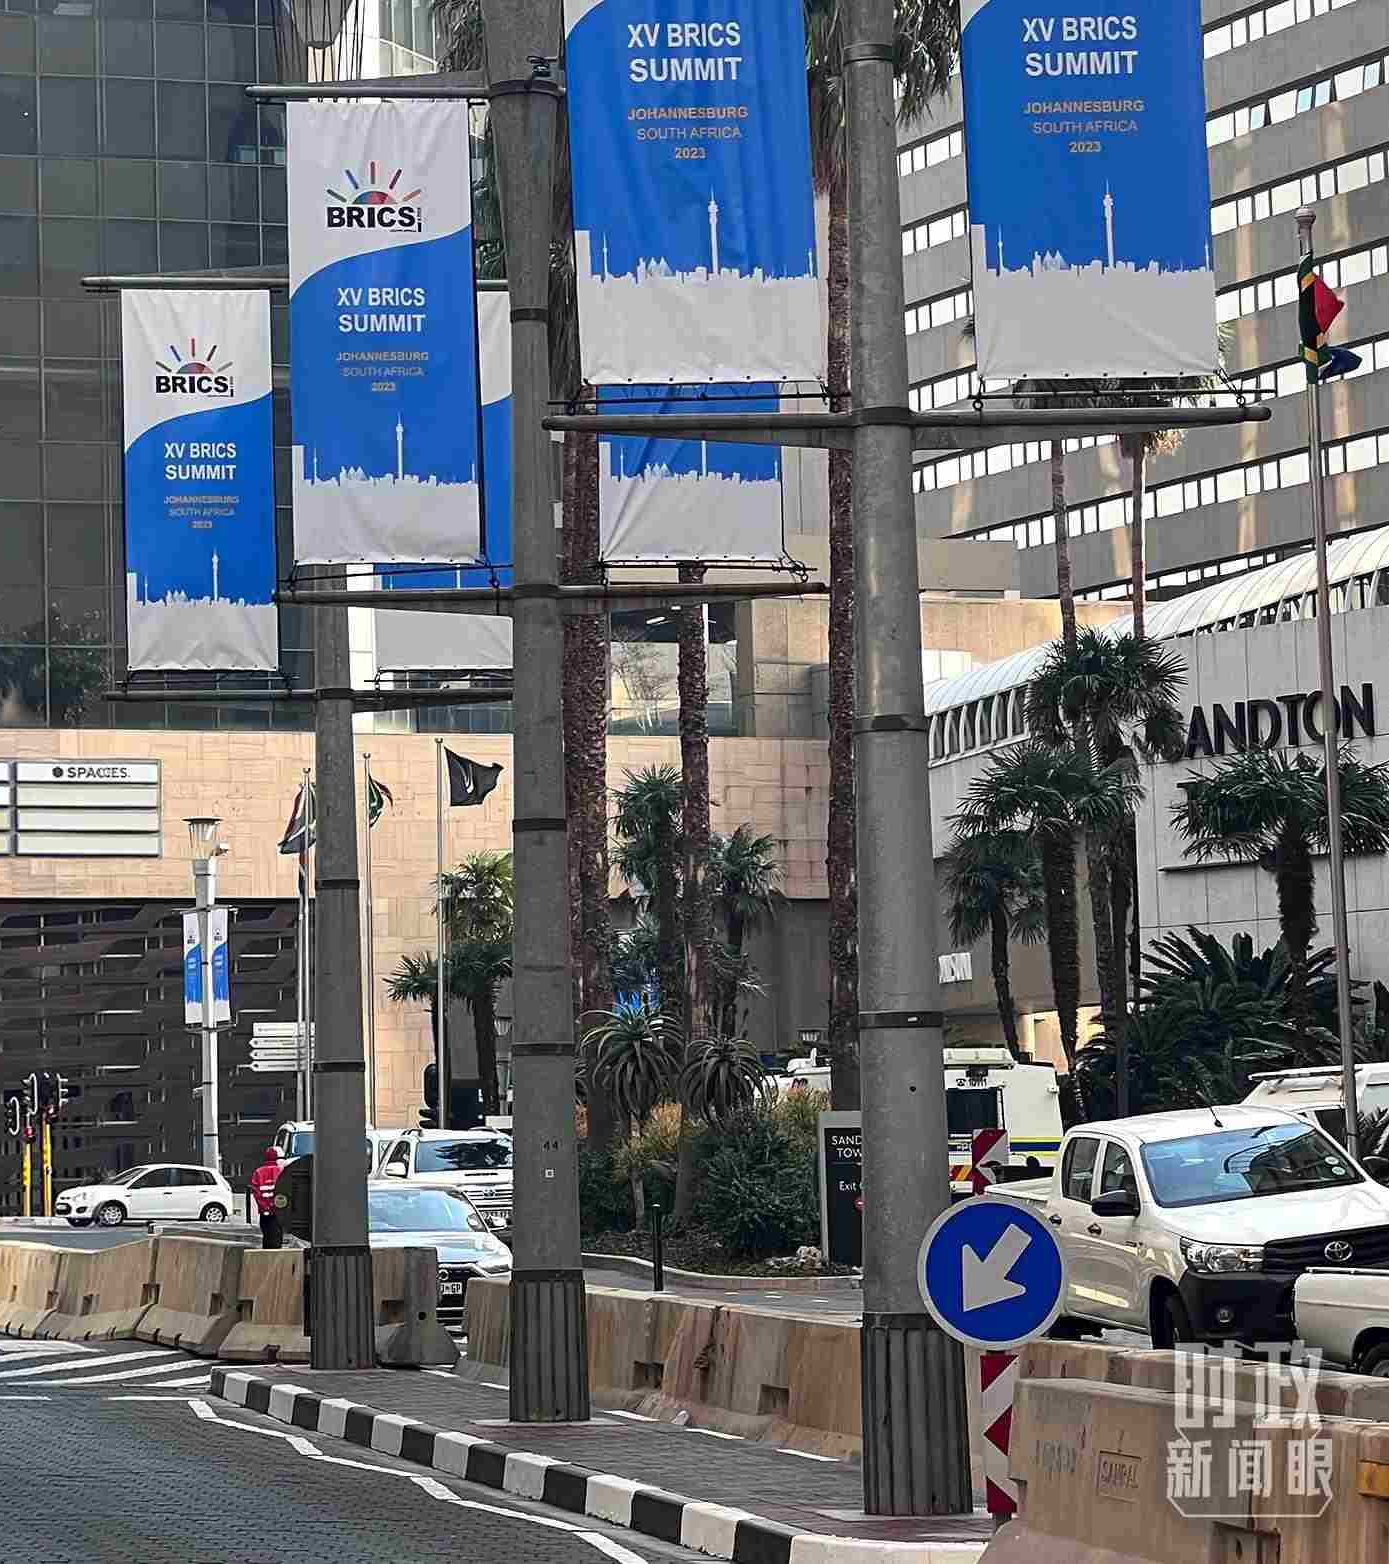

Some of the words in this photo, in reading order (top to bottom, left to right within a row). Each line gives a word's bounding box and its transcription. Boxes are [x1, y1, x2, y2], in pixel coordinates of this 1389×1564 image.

[627, 23, 660, 49] XV
[666, 21, 742, 48] BRICS
[1021, 17, 1055, 43] XV
[1061, 15, 1138, 42] BRICS
[629, 56, 743, 83] SUMMIT
[1024, 50, 1139, 77] SUMMIT
[627, 105, 749, 122] JOHANNESBURG
[1023, 99, 1145, 115] JOHANNESBURG
[636, 126, 687, 142] SOUTH
[690, 125, 742, 140] AFRICA
[1031, 119, 1083, 134] SOUTH
[1085, 118, 1139, 133] AFRICA
[674, 146, 706, 160] 2023
[1068, 140, 1102, 154] 2023
[326, 206, 416, 229] BRICS
[337, 287, 363, 307] XV
[367, 287, 426, 307] BRICS
[338, 313, 427, 333] SUMMIT
[336, 351, 429, 362] JOHANNESBURG
[342, 366, 381, 378] SOUTH
[383, 366, 424, 378] AFRICA
[155, 375, 229, 395] BRICS
[371, 382, 396, 392] 2023
[164, 442, 186, 459] XV
[189, 441, 237, 459] BRICS
[164, 464, 237, 481] SUMMIT
[1184, 682, 1376, 760] ANDTON
[831, 1135, 863, 1146] SAND
[836, 1147, 863, 1159] TOW
[838, 1180, 857, 1192] Exit
